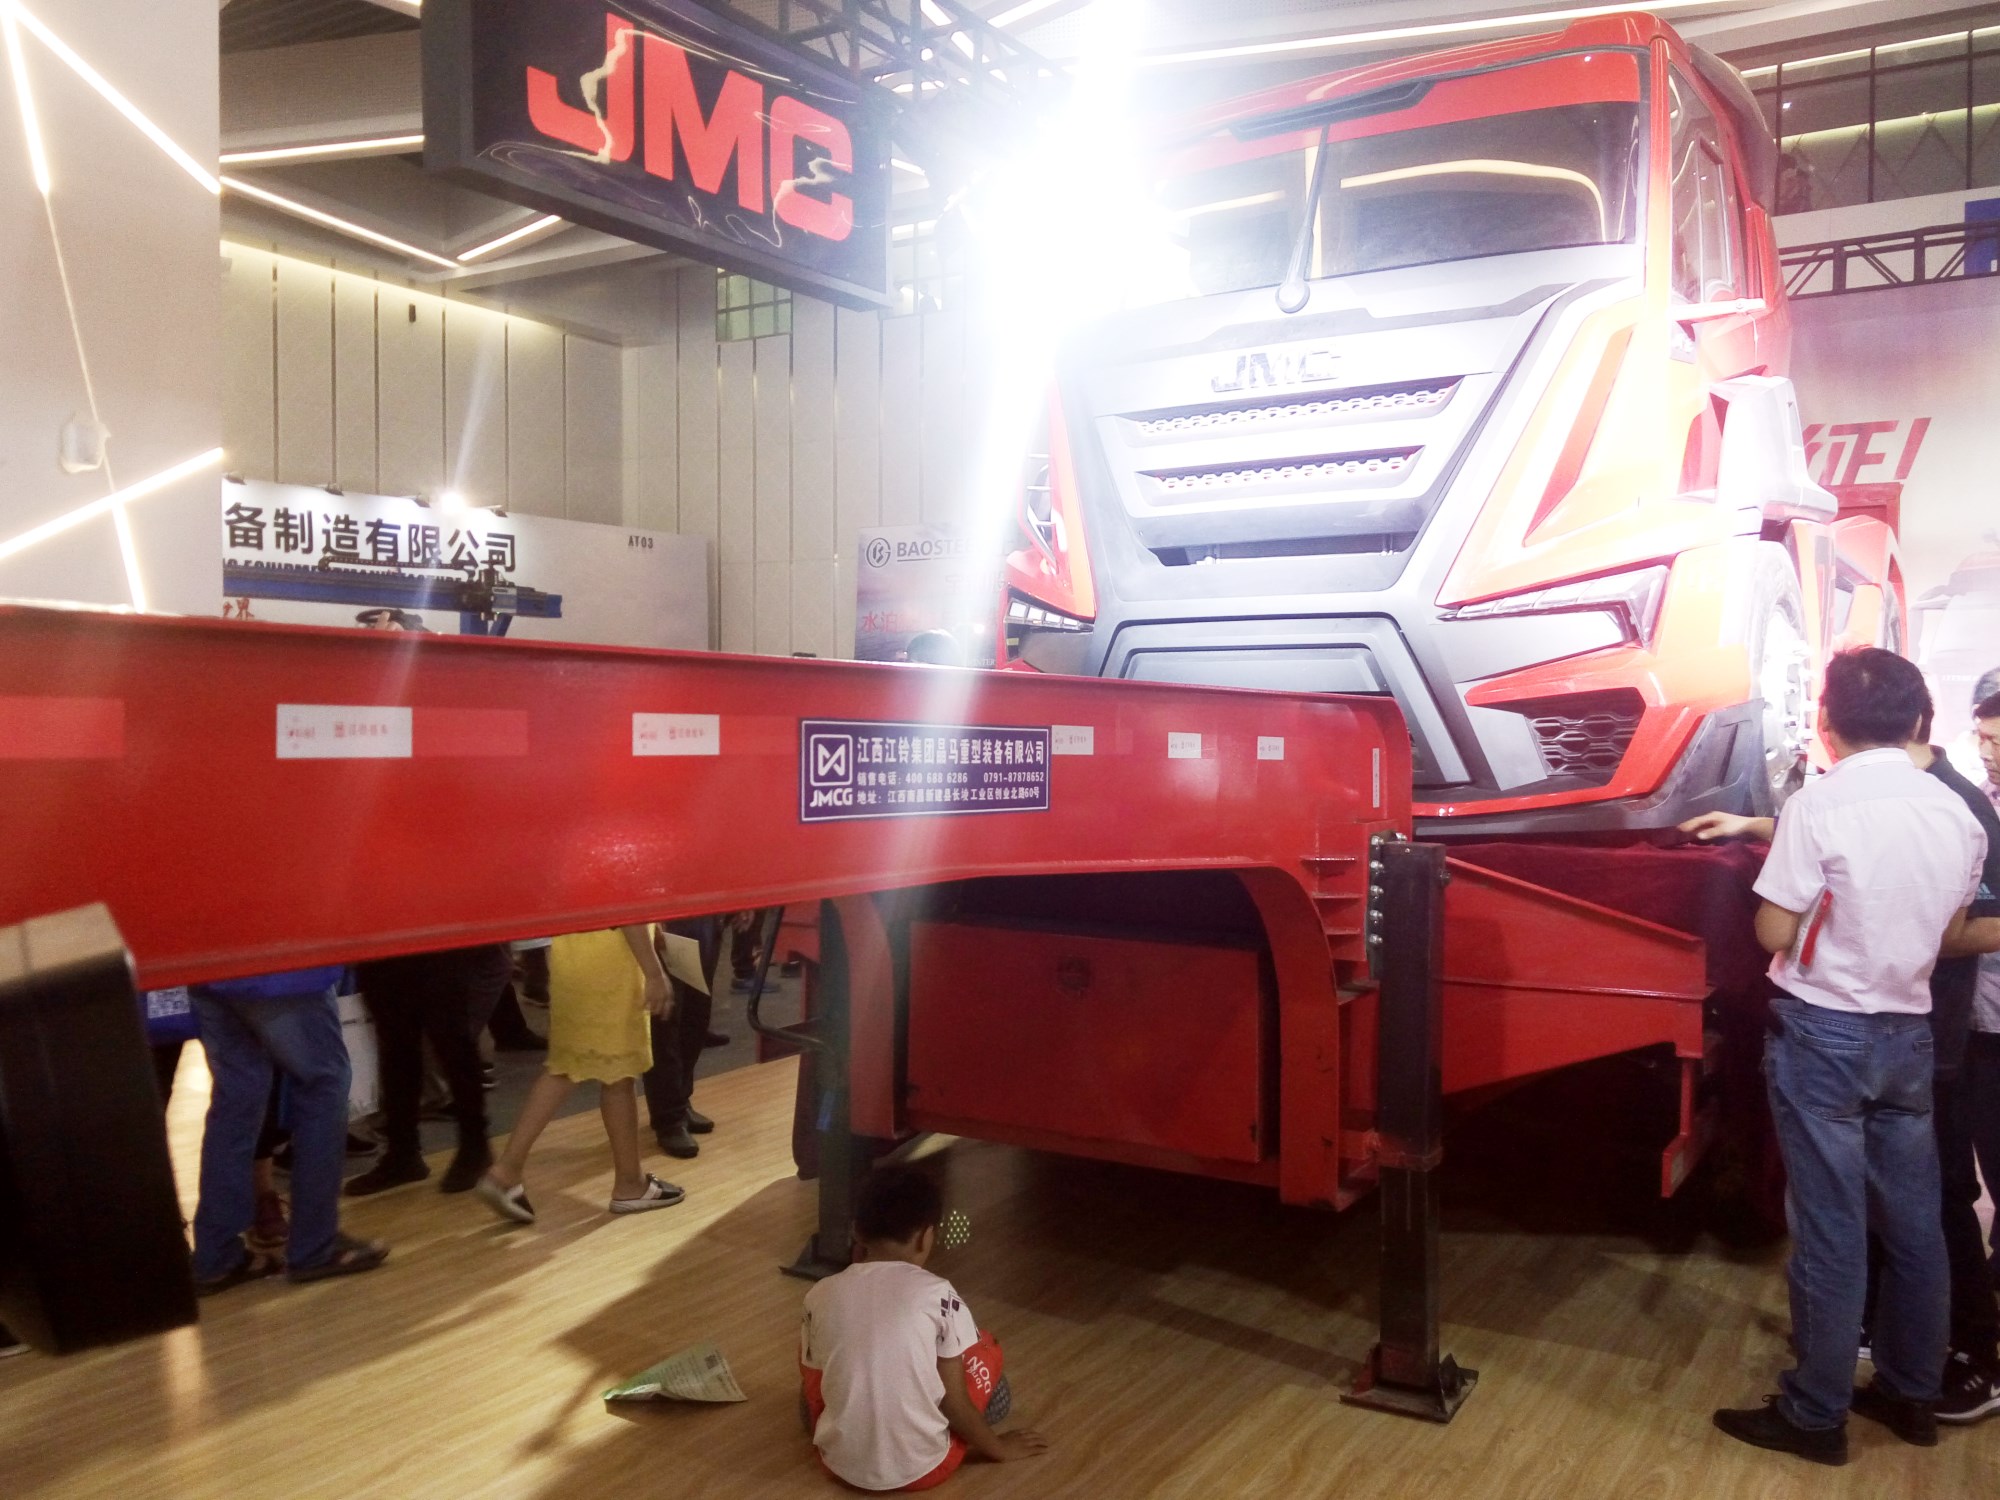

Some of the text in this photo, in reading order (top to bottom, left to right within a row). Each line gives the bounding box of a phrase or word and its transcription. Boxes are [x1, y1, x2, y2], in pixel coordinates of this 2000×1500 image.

[526, 12, 853, 241] JMC
[1211, 351, 1341, 393] JMC
[224, 502, 517, 573] 备制造有限公司
[628, 535, 654, 549] AT03
[857, 736, 1044, 765] 江西江铃集团晶马重型装备有限公司
[905, 772, 923, 784] 400
[946, 772, 968, 784] 6286
[983, 771, 1045, 783] 0791-87878652
[809, 788, 854, 808] JMCG
